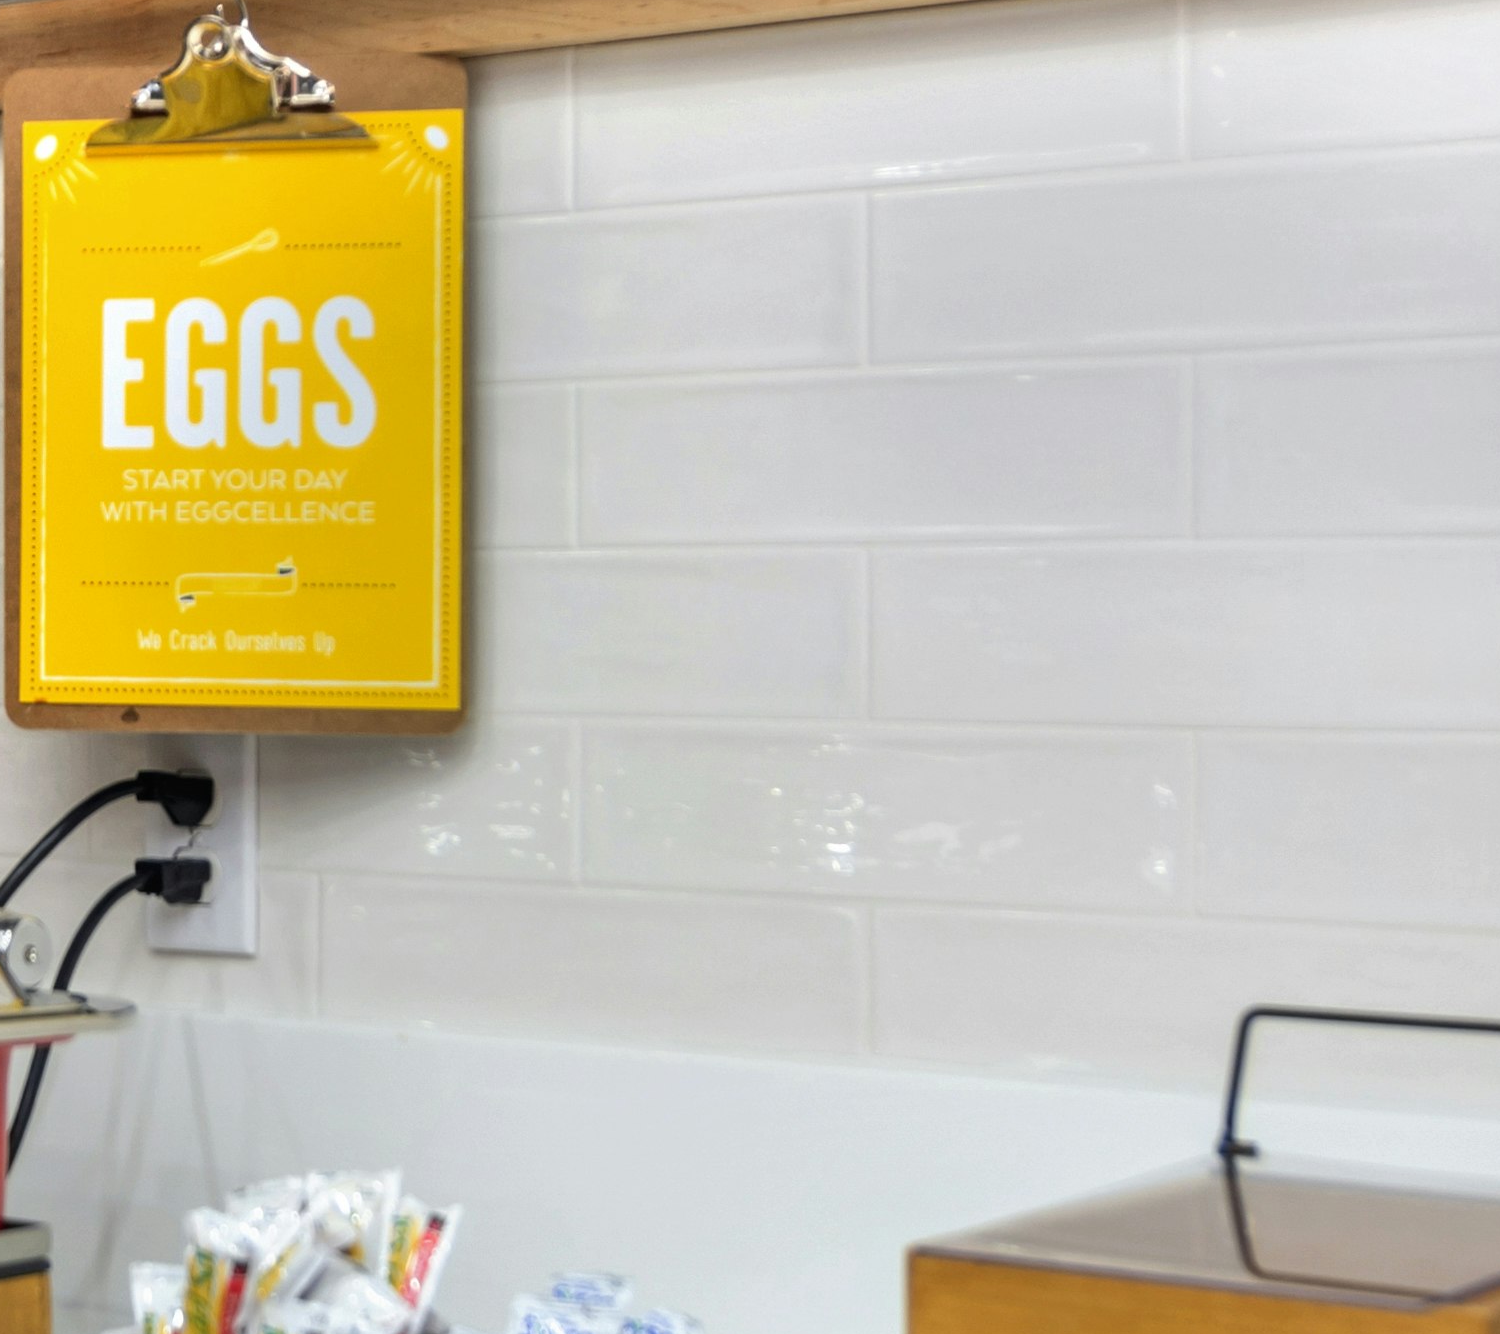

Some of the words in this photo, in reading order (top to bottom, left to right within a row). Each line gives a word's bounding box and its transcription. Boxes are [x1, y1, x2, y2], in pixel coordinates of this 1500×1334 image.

[101, 294, 379, 450] EGGS
[122, 468, 205, 491] START
[210, 469, 287, 491] YOUR
[294, 469, 348, 491] DAY
[100, 500, 168, 523] WITH
[175, 501, 376, 524] EGGCELLENCE
[137, 629, 162, 651] We
[169, 629, 217, 651] Crack
[224, 629, 306, 652] Ourselves
[313, 632, 336, 656] Up
